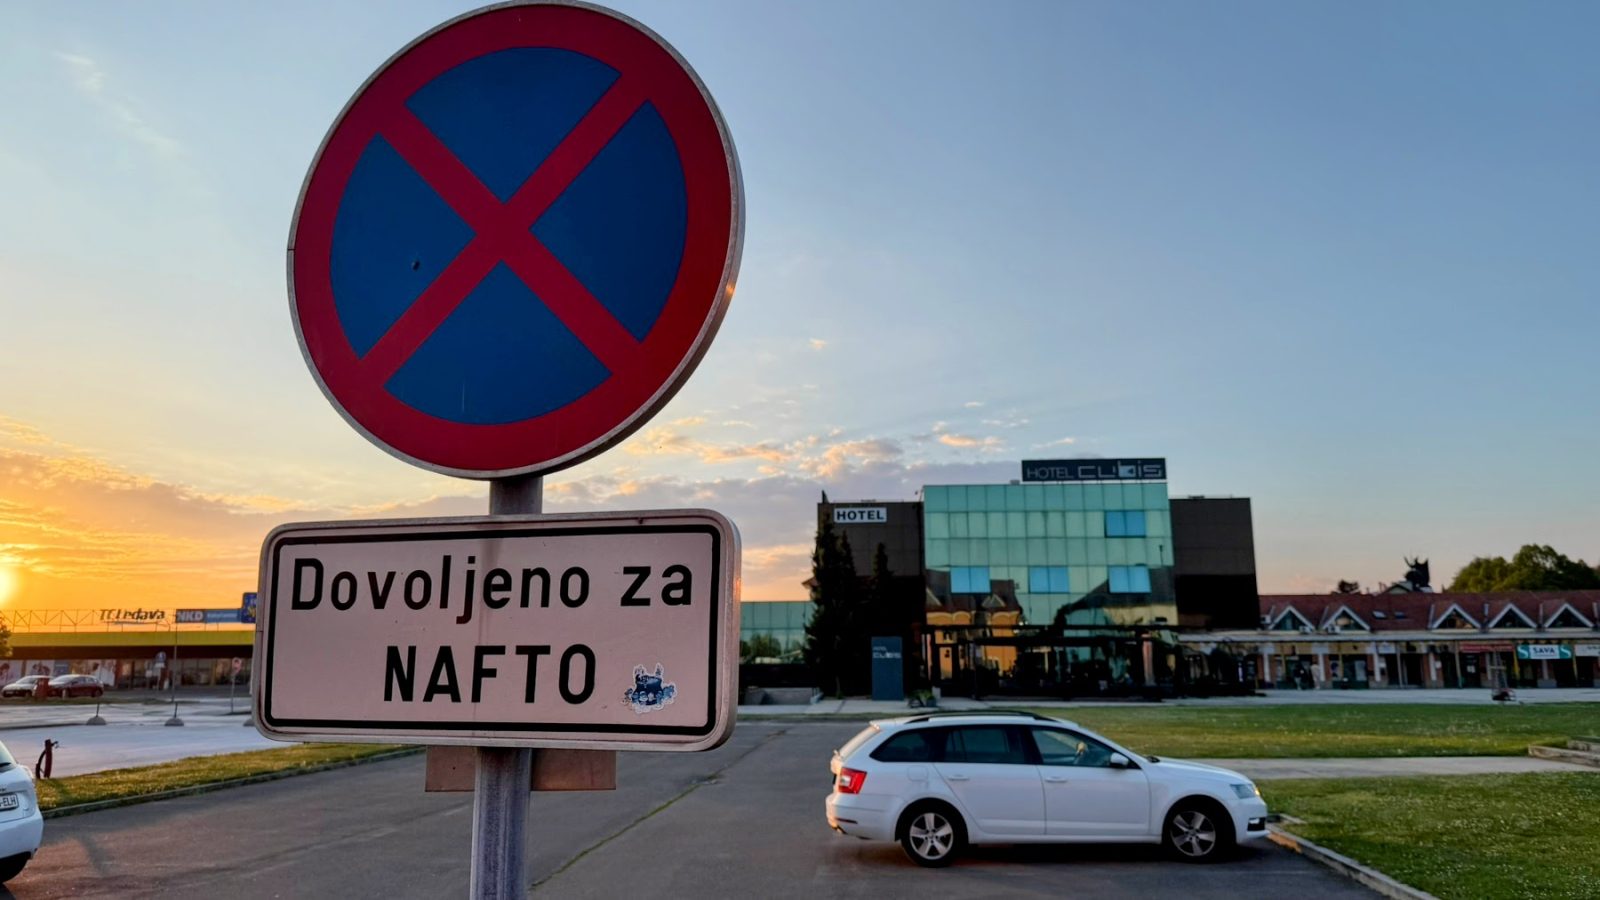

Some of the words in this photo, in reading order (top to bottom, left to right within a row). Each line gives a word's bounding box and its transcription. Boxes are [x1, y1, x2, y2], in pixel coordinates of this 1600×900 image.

[1027, 467, 1074, 479] HOTEL
[836, 510, 885, 520] HOTEL
[291, 555, 590, 625] Dovoljeno
[620, 564, 693, 606] za
[177, 611, 204, 622] NKD
[1533, 646, 1556, 654] SAVA
[384, 644, 596, 705] NAFTO
[0, 796, 16, 807] -ELH
